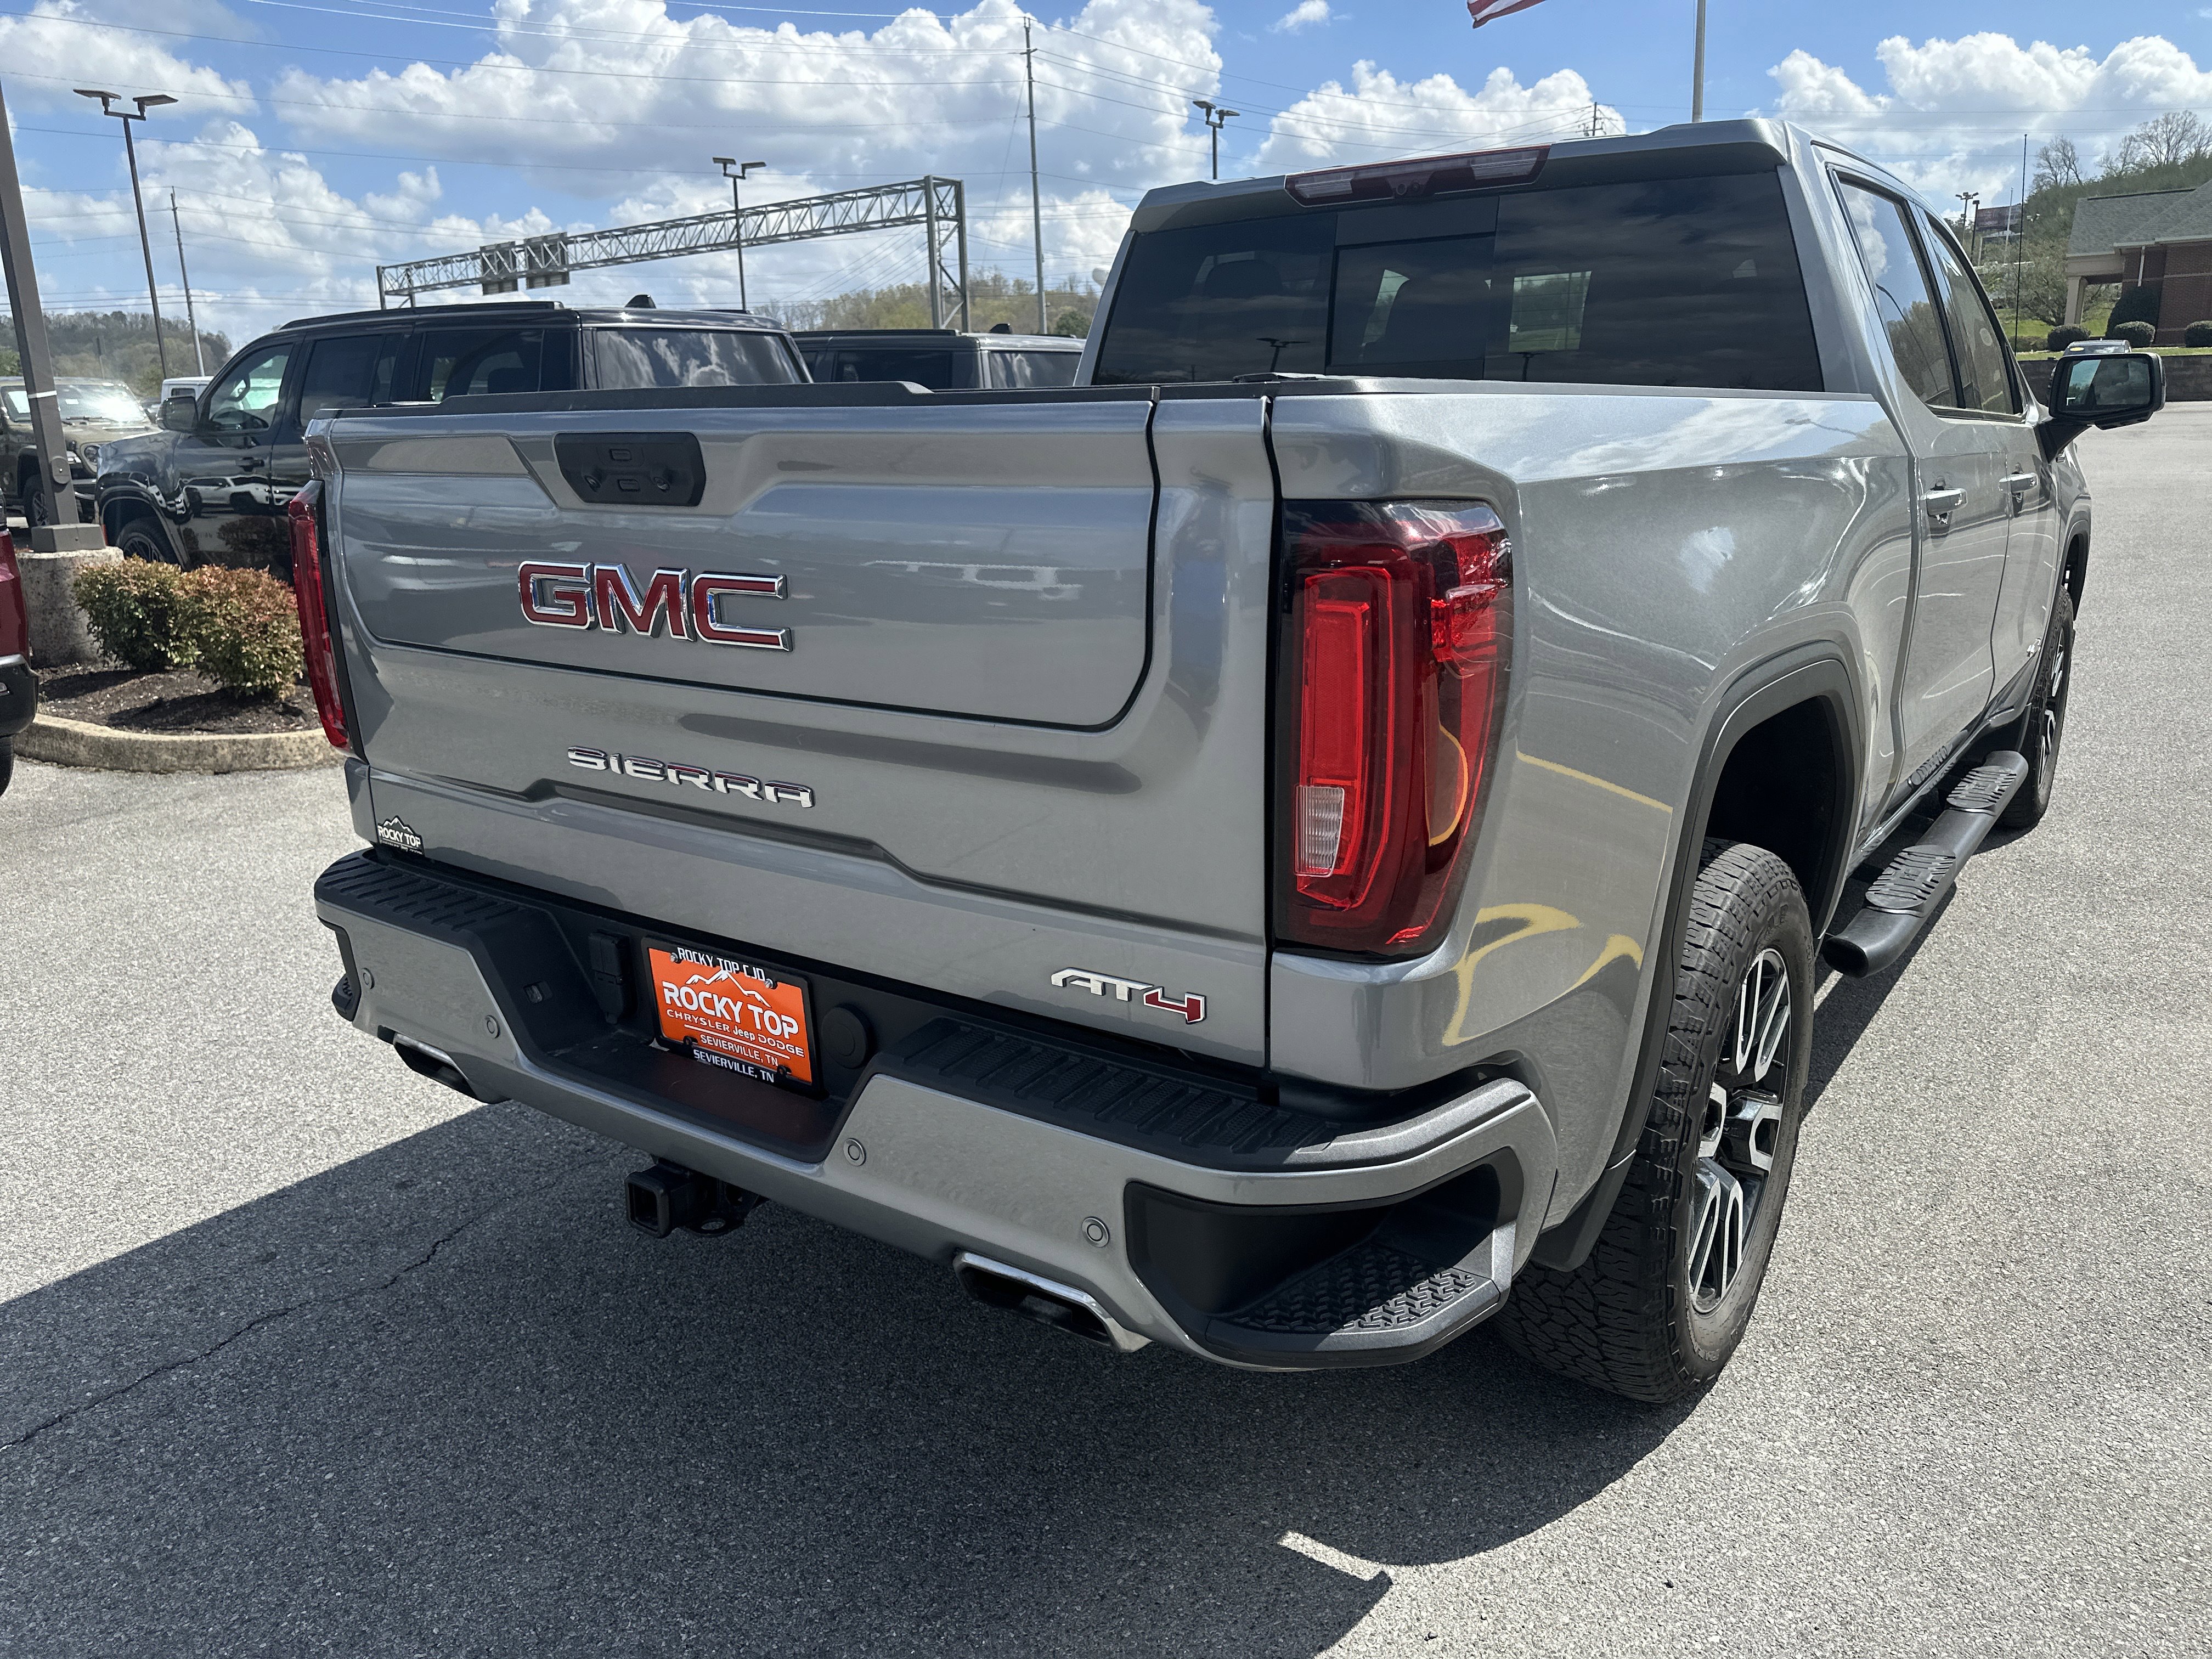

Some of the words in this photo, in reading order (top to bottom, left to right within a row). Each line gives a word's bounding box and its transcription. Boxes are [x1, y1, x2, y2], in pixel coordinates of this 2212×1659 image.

[518, 560, 793, 652] GMC
[567, 745, 815, 808] SIERRA
[377, 825, 403, 843] ROCKY
[404, 833, 421, 848] TOP
[677, 947, 713, 968] ROCKY
[716, 957, 740, 974] TOP
[743, 964, 766, 981] CJD
[662, 980, 743, 1024] ROCKY
[747, 1003, 799, 1039] TOP
[1051, 967, 1207, 1025] AT4
[667, 1009, 730, 1032] CHRYSLER
[732, 1024, 755, 1041] Jeep
[758, 1034, 805, 1057] DODGE
[700, 1034, 763, 1063] SEVIERVILLE,
[765, 1053, 779, 1066] TN
[693, 1048, 758, 1079] SEVIERVILLE,
[760, 1069, 774, 1083] TN
